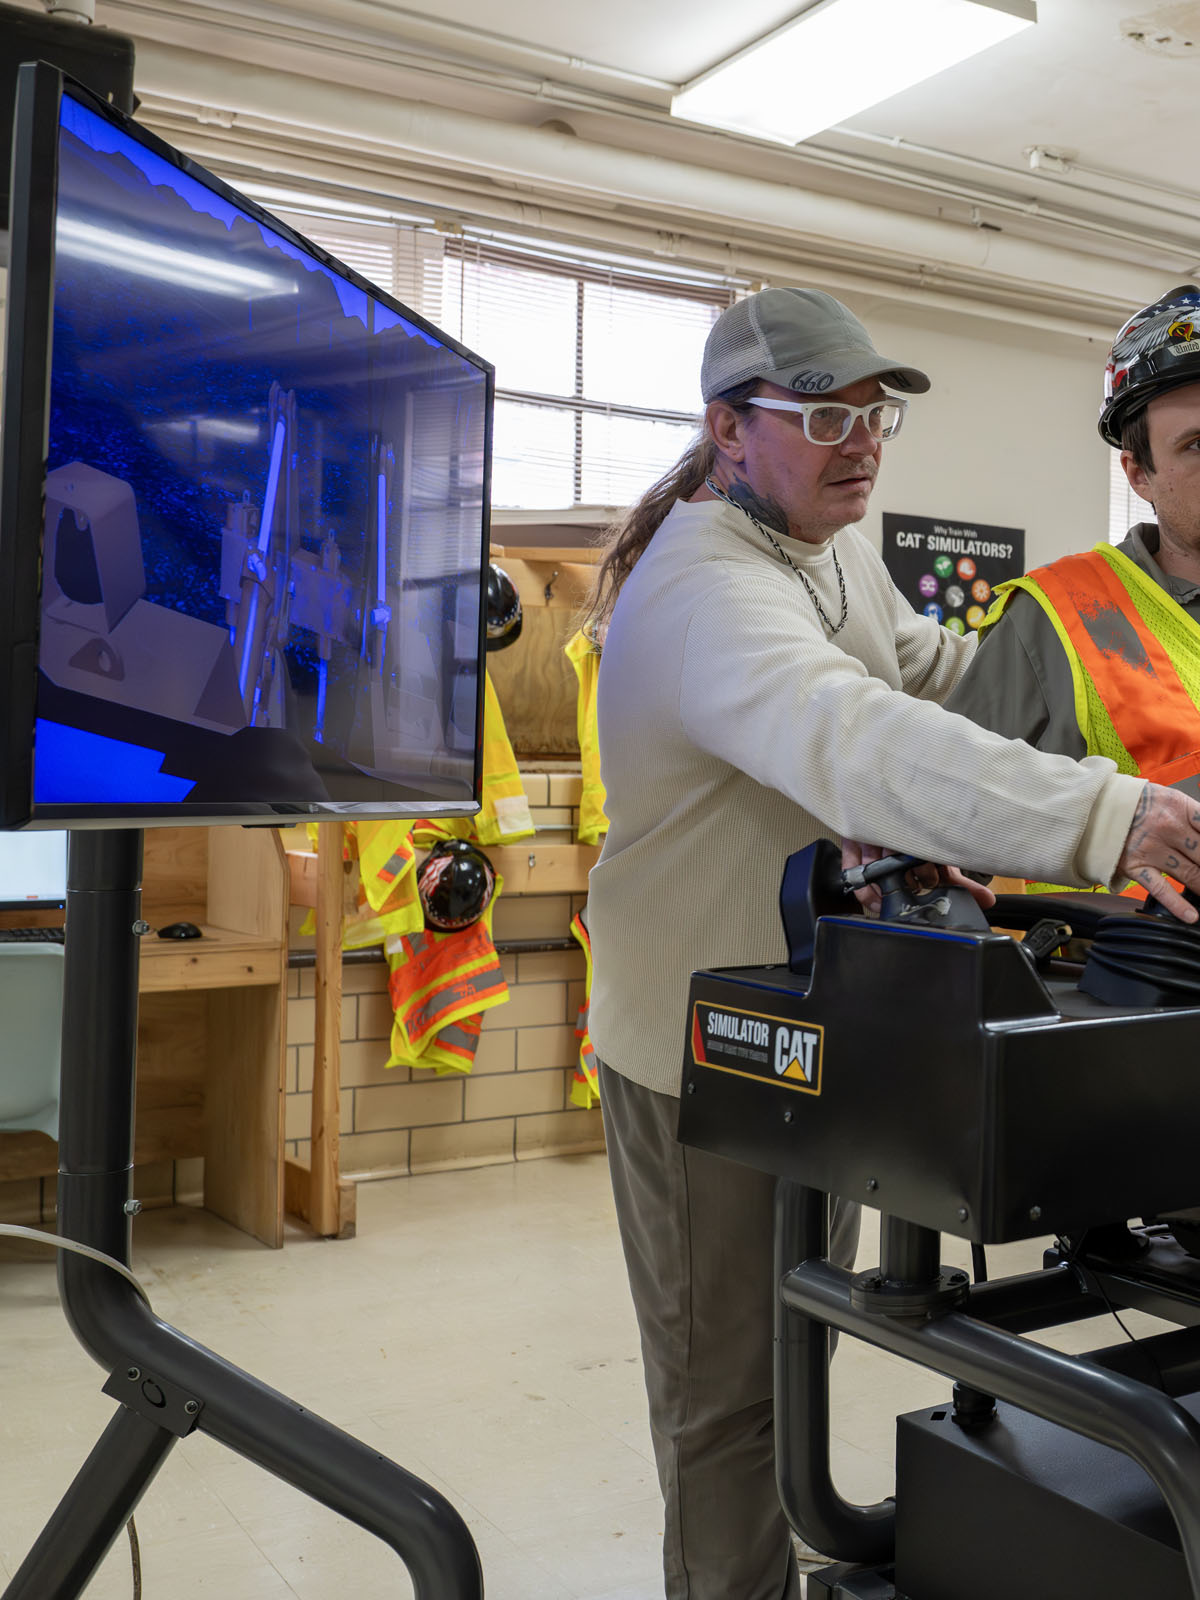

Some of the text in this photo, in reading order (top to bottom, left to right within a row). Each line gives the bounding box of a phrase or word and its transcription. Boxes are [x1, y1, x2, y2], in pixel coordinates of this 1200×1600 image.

[1174, 342, 1199, 354] United
[789, 369, 834, 392] 660
[934, 526, 978, 538] Why Train With
[927, 535, 1013, 560] SIMULATORS?
[707, 1011, 770, 1047] SIMULATOR
[774, 1026, 818, 1083] CAT
